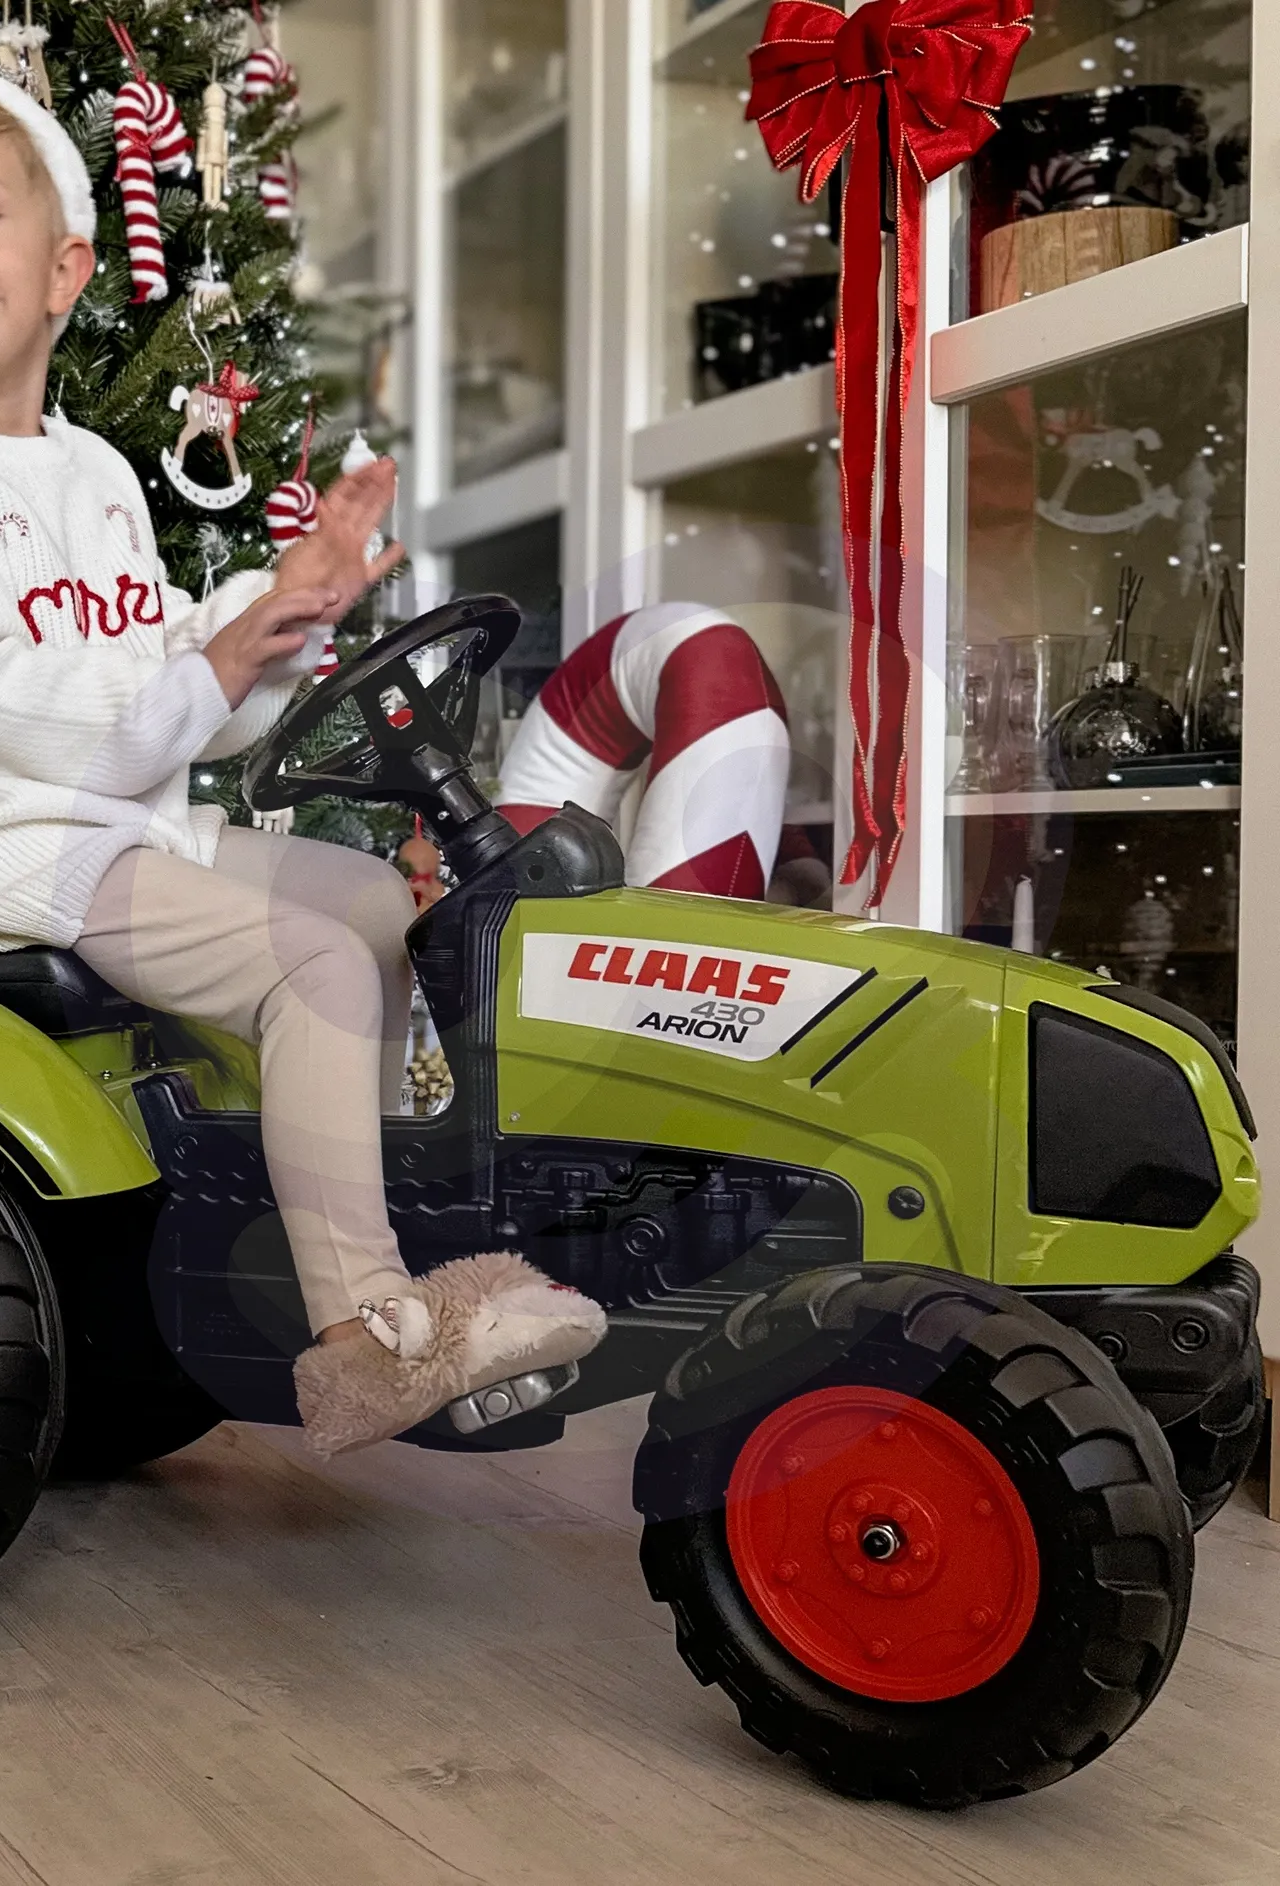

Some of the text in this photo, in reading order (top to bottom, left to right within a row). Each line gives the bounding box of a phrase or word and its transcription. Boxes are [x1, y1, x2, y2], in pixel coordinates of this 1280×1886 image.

[567, 942, 790, 1005] CLAAS
[636, 1011, 749, 1044] ARION
[689, 1000, 766, 1026] 430
